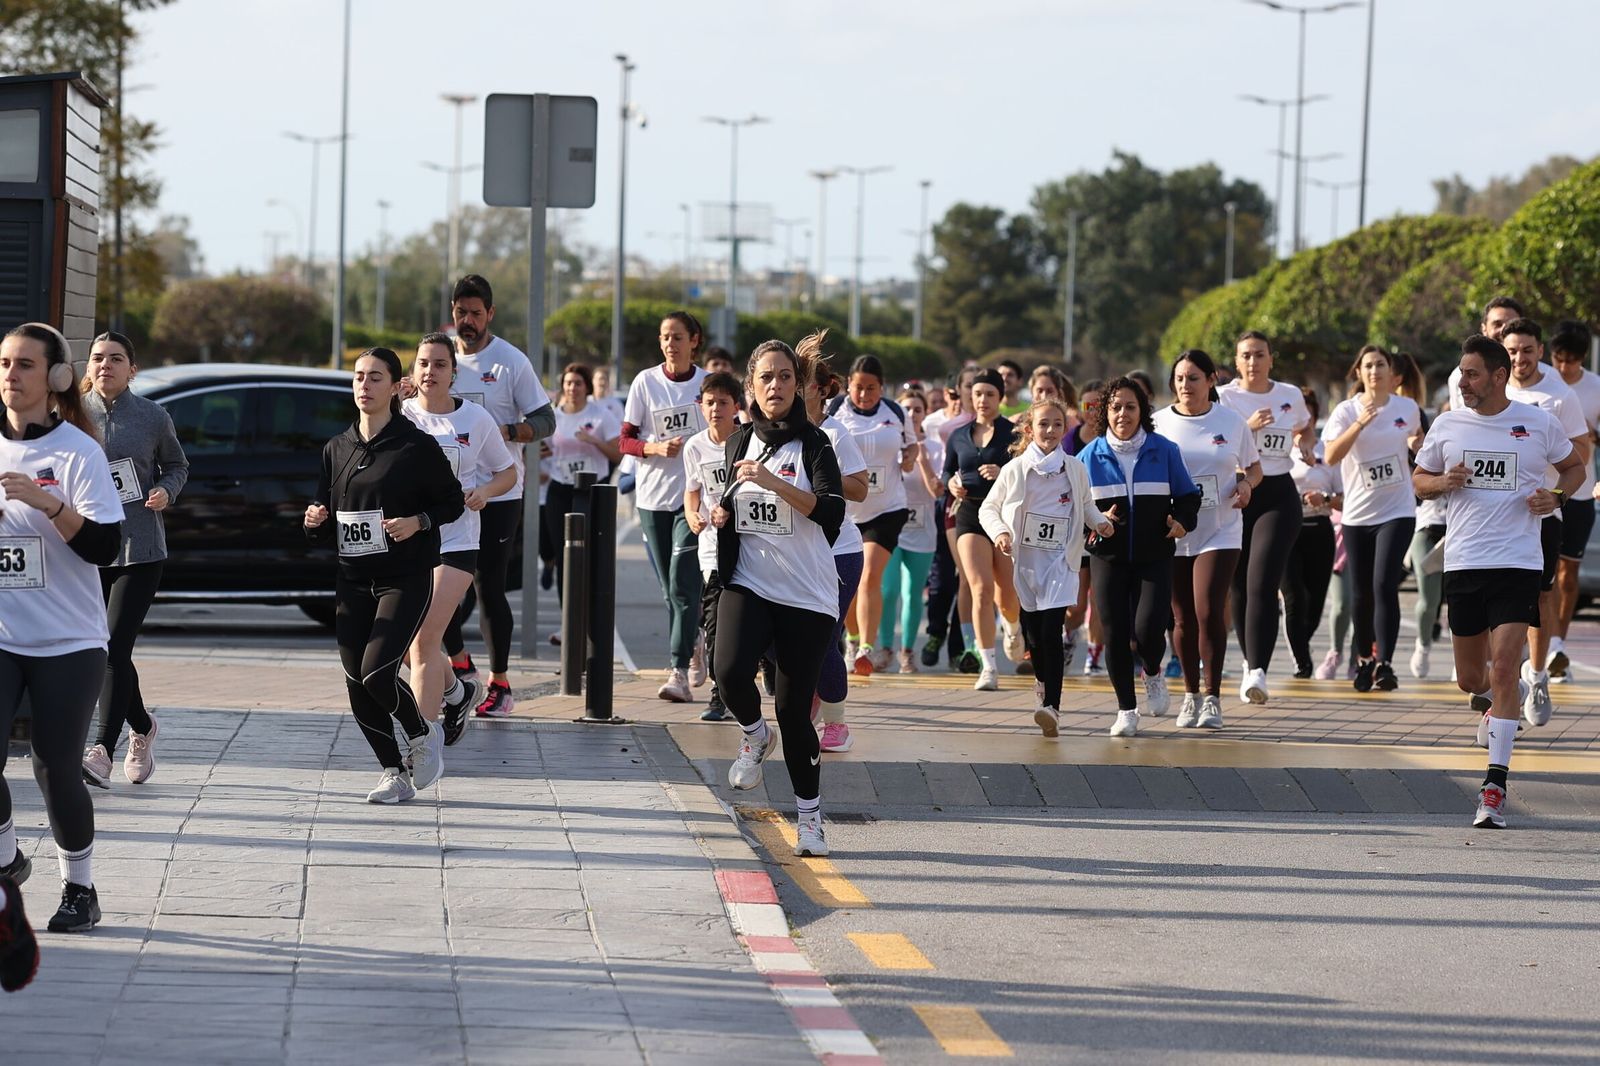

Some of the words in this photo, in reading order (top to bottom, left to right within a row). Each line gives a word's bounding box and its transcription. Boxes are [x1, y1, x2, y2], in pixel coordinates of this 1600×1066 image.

[664, 412, 688, 430] 247
[1264, 434, 1285, 449] 377
[1369, 463, 1393, 480] 376
[1474, 460, 1506, 478] 244
[867, 472, 877, 485] 4
[749, 501, 777, 522] 313
[343, 522, 371, 542] 266
[1039, 523, 1055, 539] 31
[0, 548, 25, 572] 53
